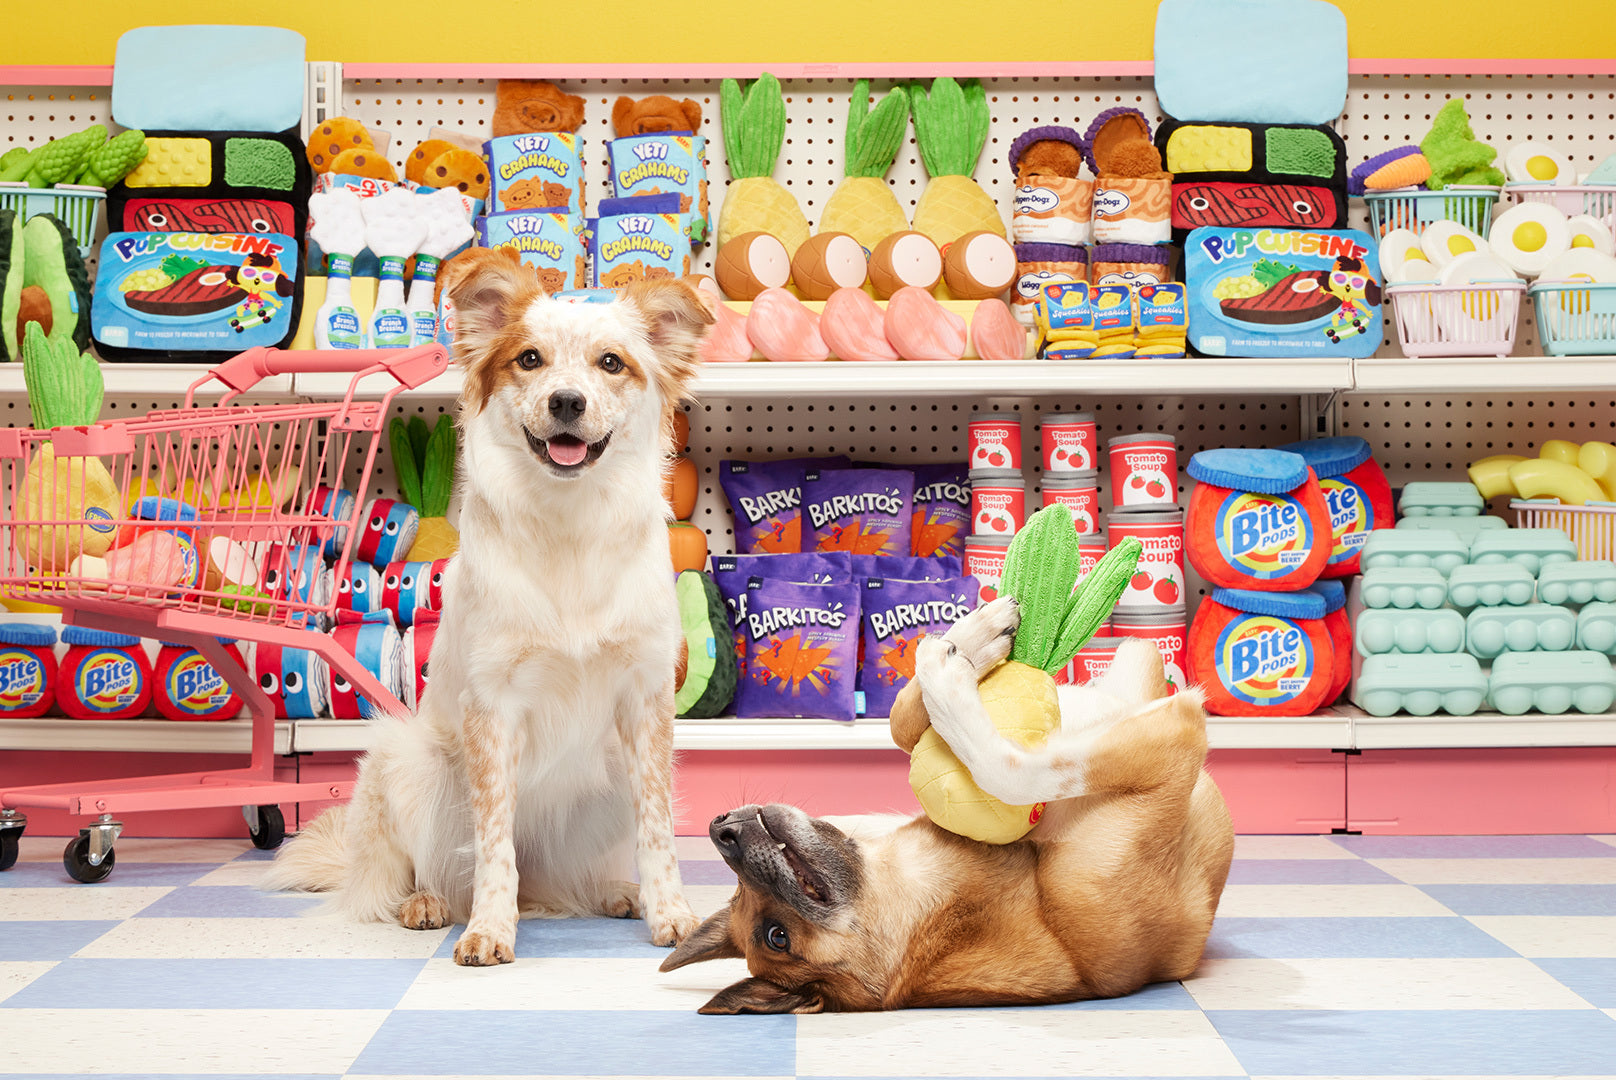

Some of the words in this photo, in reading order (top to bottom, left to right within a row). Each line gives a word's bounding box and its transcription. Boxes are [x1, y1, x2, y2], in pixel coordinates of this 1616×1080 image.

[513, 136, 550, 153] YETI
[633, 141, 669, 161] YETI
[499, 153, 569, 180] GRAHAMS
[619, 161, 689, 189] GRAHAMS
[507, 215, 544, 235] YETI
[617, 215, 654, 235] YETI
[493, 236, 564, 260] AHAMS
[601, 236, 673, 262] GRAHAMS
[1052, 307, 1091, 318] Squeakies
[1143, 306, 1183, 315] Squeakies
[333, 322, 357, 332] Dressing
[335, 316, 355, 325] Branch
[381, 319, 402, 327] Branch
[379, 325, 404, 333] Dressing
[974, 430, 1008, 438] Tomato
[979, 437, 1002, 445] Soup
[1053, 431, 1087, 439] Tomato
[1058, 438, 1081, 446] Soup
[1126, 454, 1167, 463] Tomato
[1133, 463, 1160, 471] Soup
[912, 482, 973, 505] KITOS
[979, 495, 1012, 503] Tomato
[739, 487, 801, 522] BARK
[983, 502, 1006, 510] Soup
[1326, 487, 1357, 515] te
[1332, 509, 1356, 528] ODS
[1231, 504, 1297, 556] Bite
[1262, 526, 1296, 548] PODS
[1139, 538, 1180, 549] mato
[969, 557, 1004, 567] Tomato
[1280, 556, 1301, 564] BERRY
[973, 567, 997, 576] Soup
[1231, 628, 1299, 683] Bite
[1086, 661, 1111, 669] Tom
[1262, 653, 1296, 675] PODS
[11, 676, 36, 690] PODS
[84, 660, 133, 699] Bite
[106, 677, 131, 693] PODS
[197, 678, 222, 694] PODS
